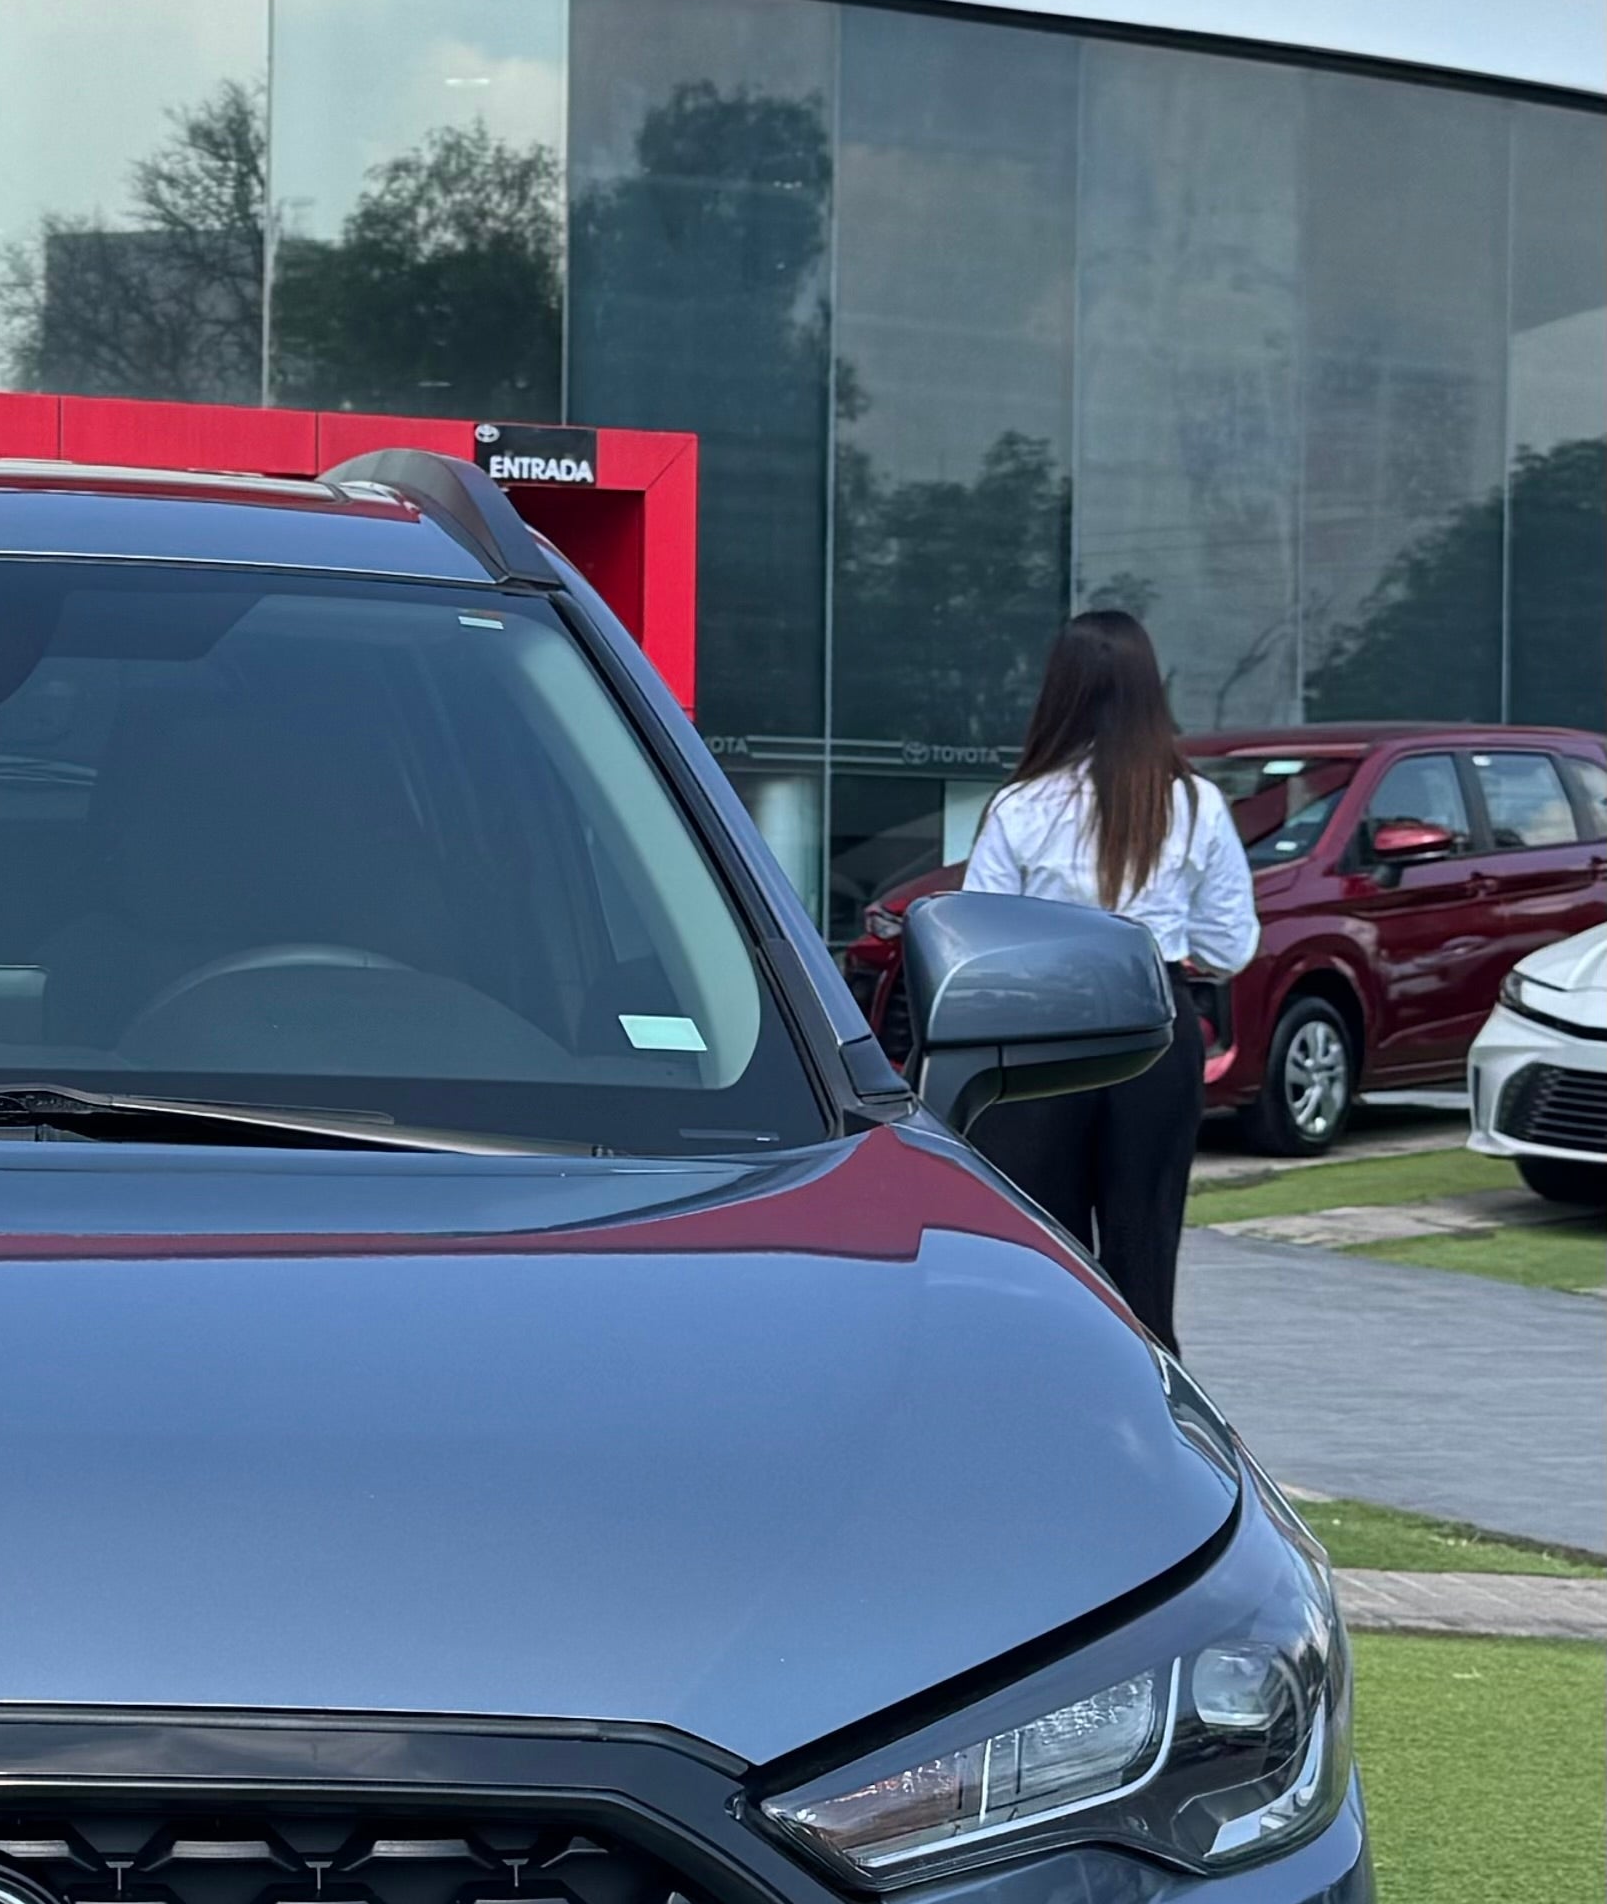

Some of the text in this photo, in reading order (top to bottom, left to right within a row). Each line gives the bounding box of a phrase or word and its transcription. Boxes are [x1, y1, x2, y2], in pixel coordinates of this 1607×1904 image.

[489, 455, 595, 484] ENTRADA
[704, 736, 748, 754] OTA
[932, 744, 1000, 764] TOYOTA
